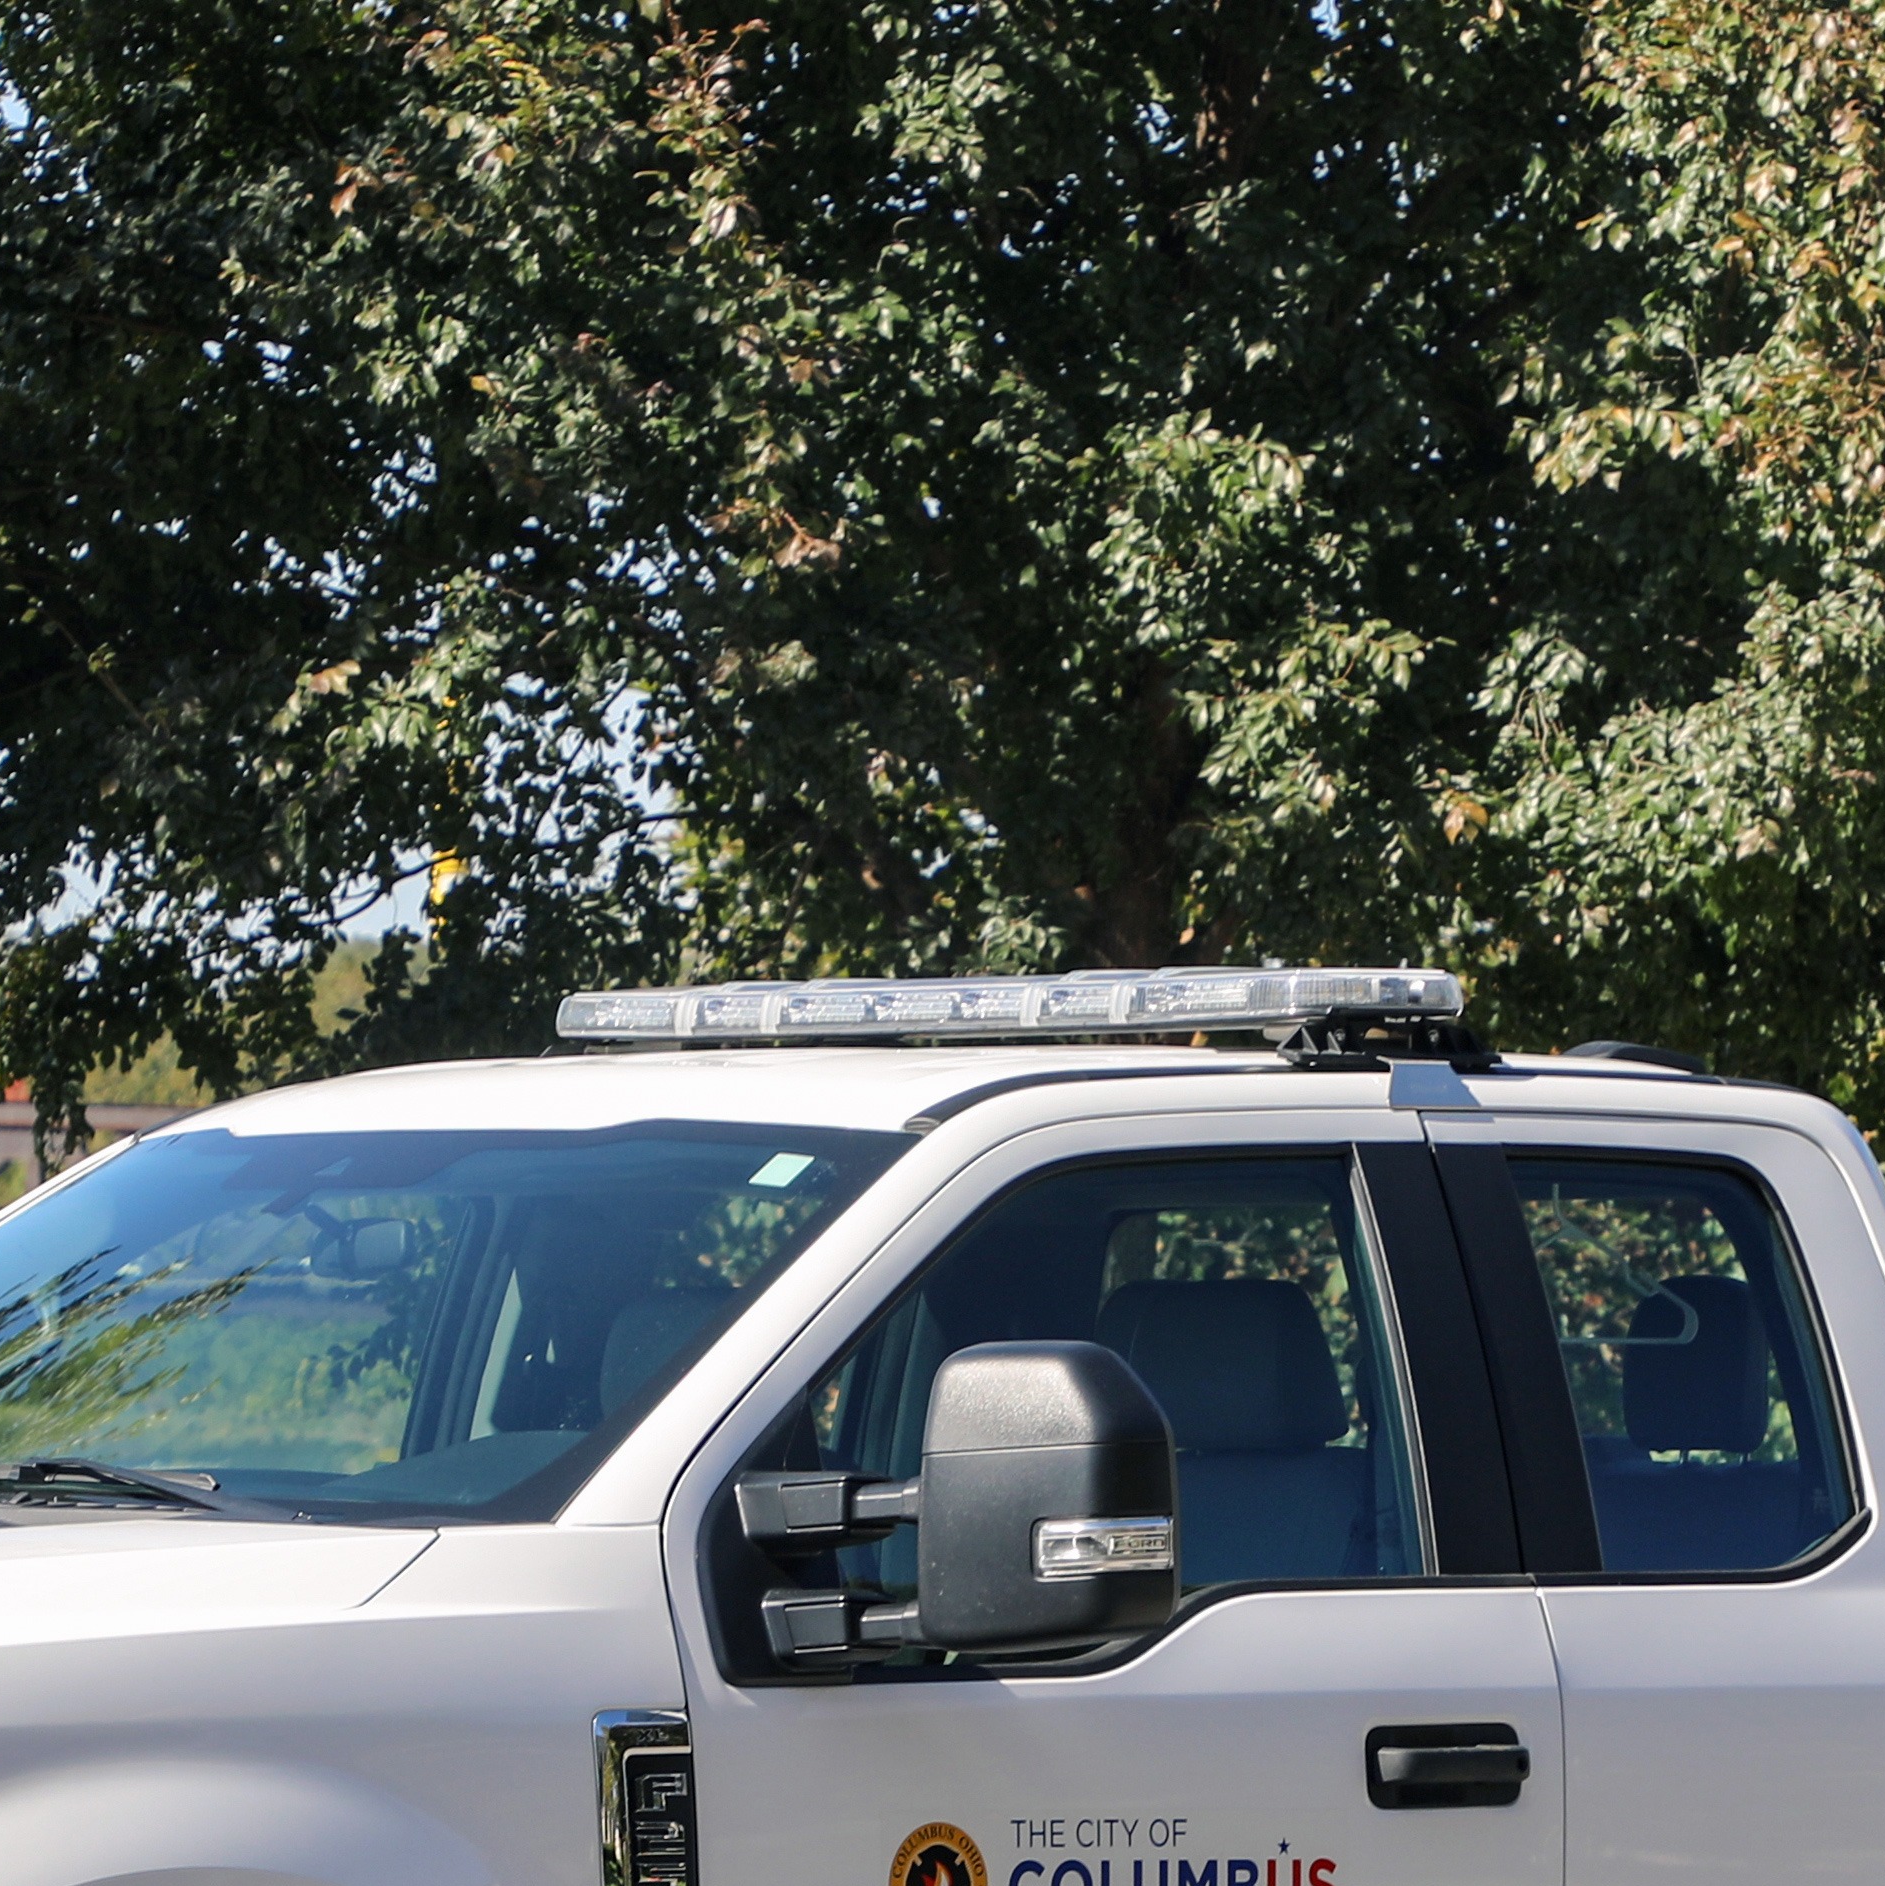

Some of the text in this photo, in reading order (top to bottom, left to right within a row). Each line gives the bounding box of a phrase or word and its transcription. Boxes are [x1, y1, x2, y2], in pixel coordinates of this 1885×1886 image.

[892, 1825, 985, 1879] COLUMBUS OHIO
[1010, 1818, 1188, 1848] THE CITY OF
